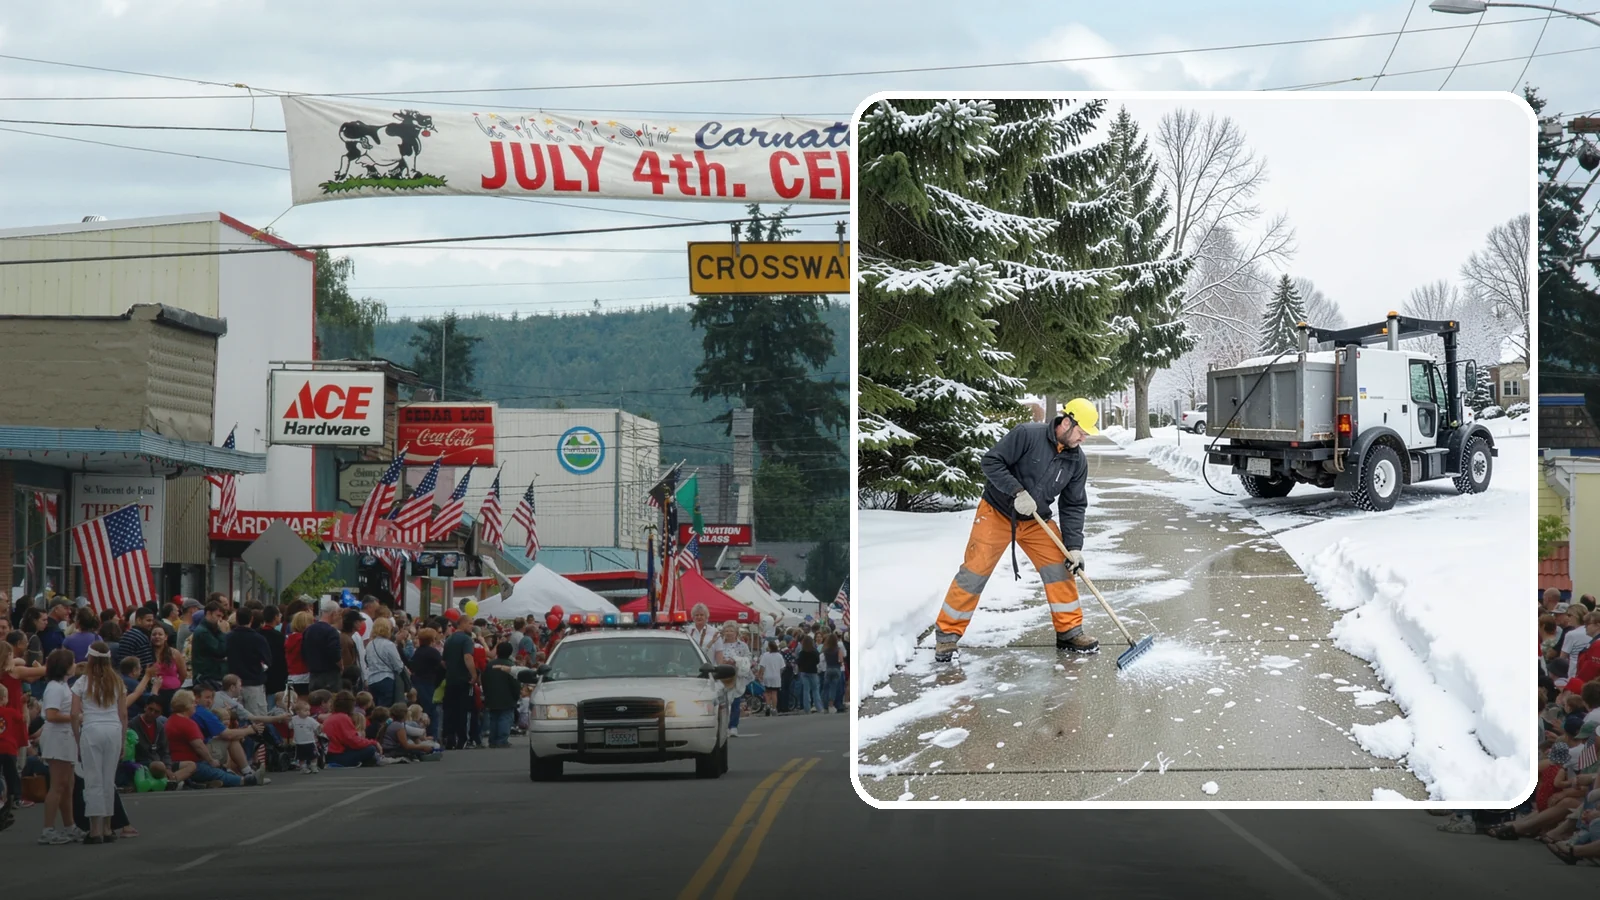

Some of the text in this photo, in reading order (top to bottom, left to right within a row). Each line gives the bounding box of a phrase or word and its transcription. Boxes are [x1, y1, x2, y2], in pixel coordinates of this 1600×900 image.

[695, 121, 850, 149] Carnat
[481, 141, 605, 193] JULY
[632, 150, 746, 197] 4th.
[697, 254, 850, 280] CROSSWA
[282, 380, 374, 420] ACE
[405, 409, 453, 422] CEDAR
[283, 421, 371, 437] Hardware
[353, 467, 384, 480] Simpl
[83, 484, 155, 496] St. Vincent de Paul
[688, 526, 741, 535] CRNATION
[699, 535, 730, 544] GLASS
